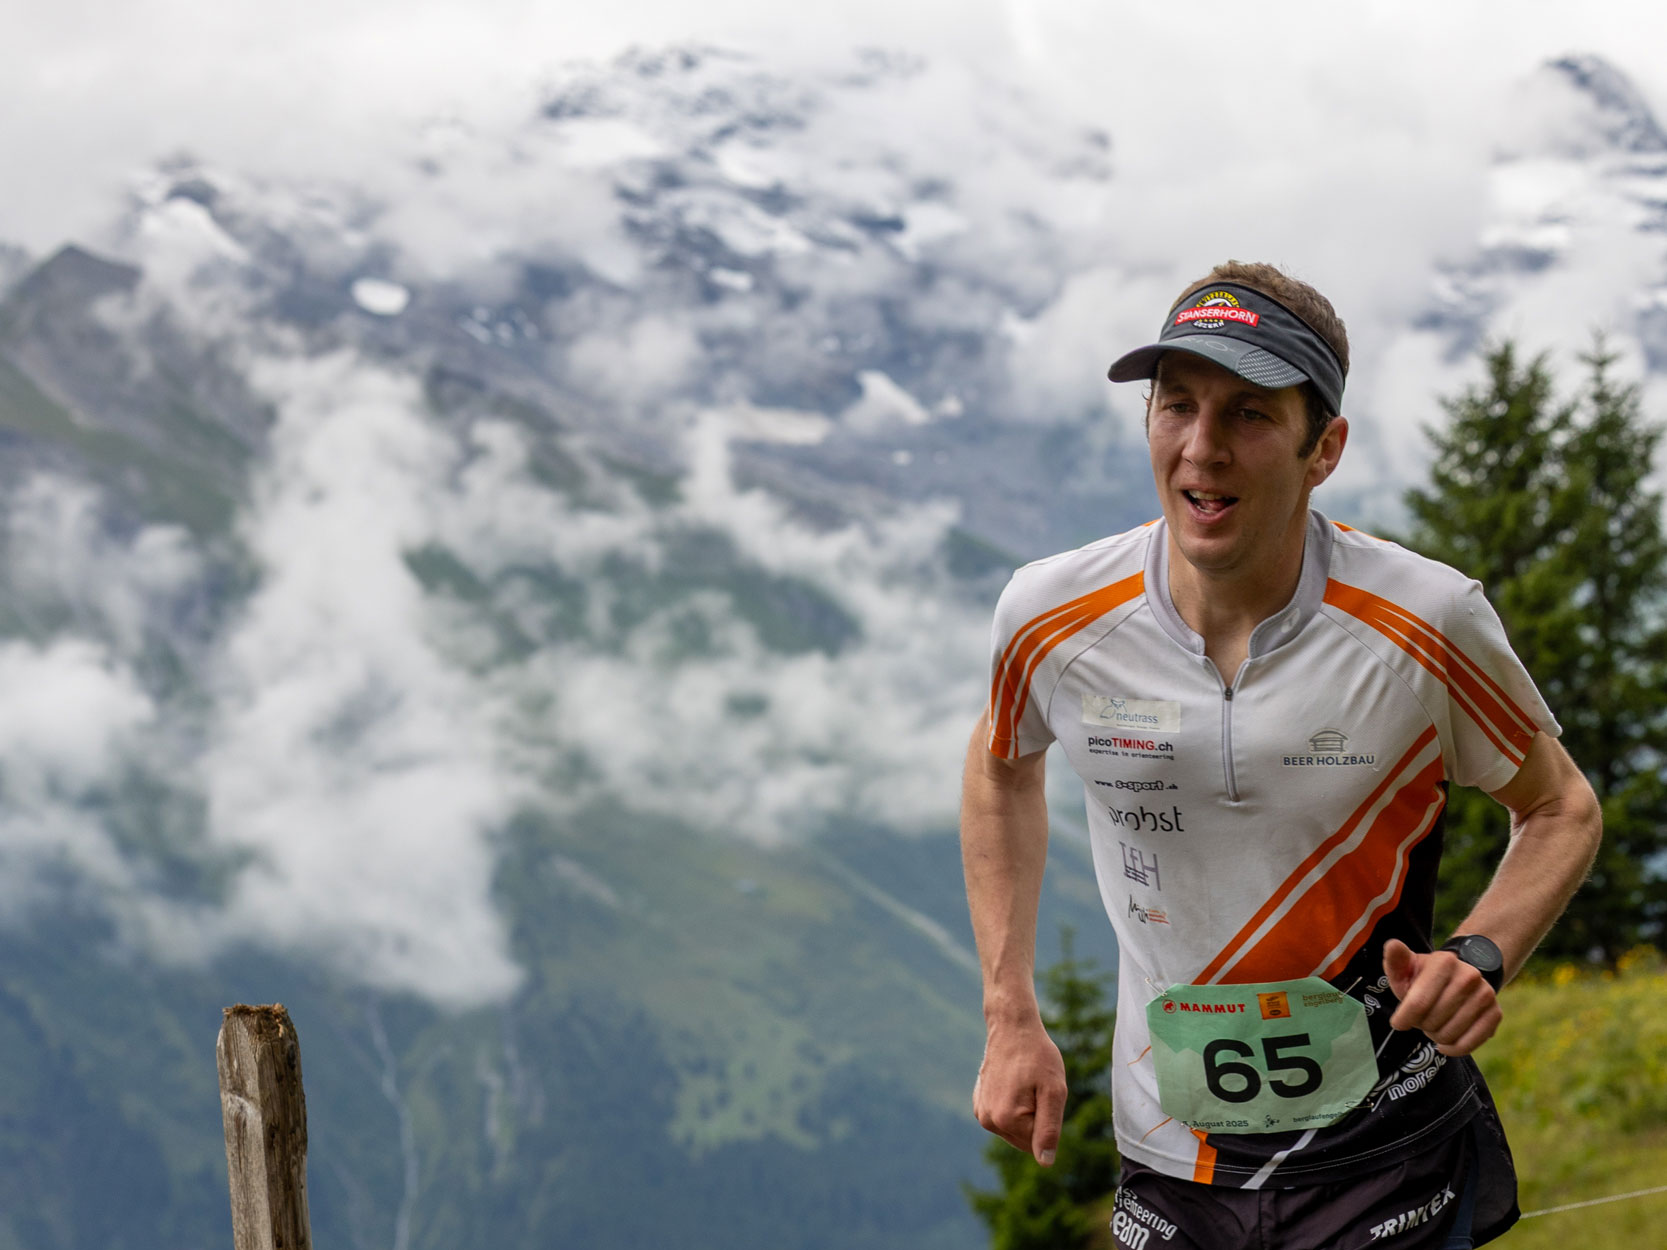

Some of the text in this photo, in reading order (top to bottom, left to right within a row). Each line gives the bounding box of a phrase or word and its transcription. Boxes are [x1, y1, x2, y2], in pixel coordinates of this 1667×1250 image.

[1177, 308, 1256, 324] STANSERHORN
[1116, 712, 1159, 724] neutrass
[1088, 736, 1174, 752] picoTIMING.ch
[1089, 748, 1119, 757] expertise
[1131, 752, 1175, 760] orienteering
[1283, 755, 1375, 766] BEER HOLZBAU
[1180, 1001, 1246, 1014] MAMMUT
[1203, 1032, 1324, 1104] 65
[1193, 1121, 1224, 1130] August
[1226, 1120, 1249, 1128] 2025
